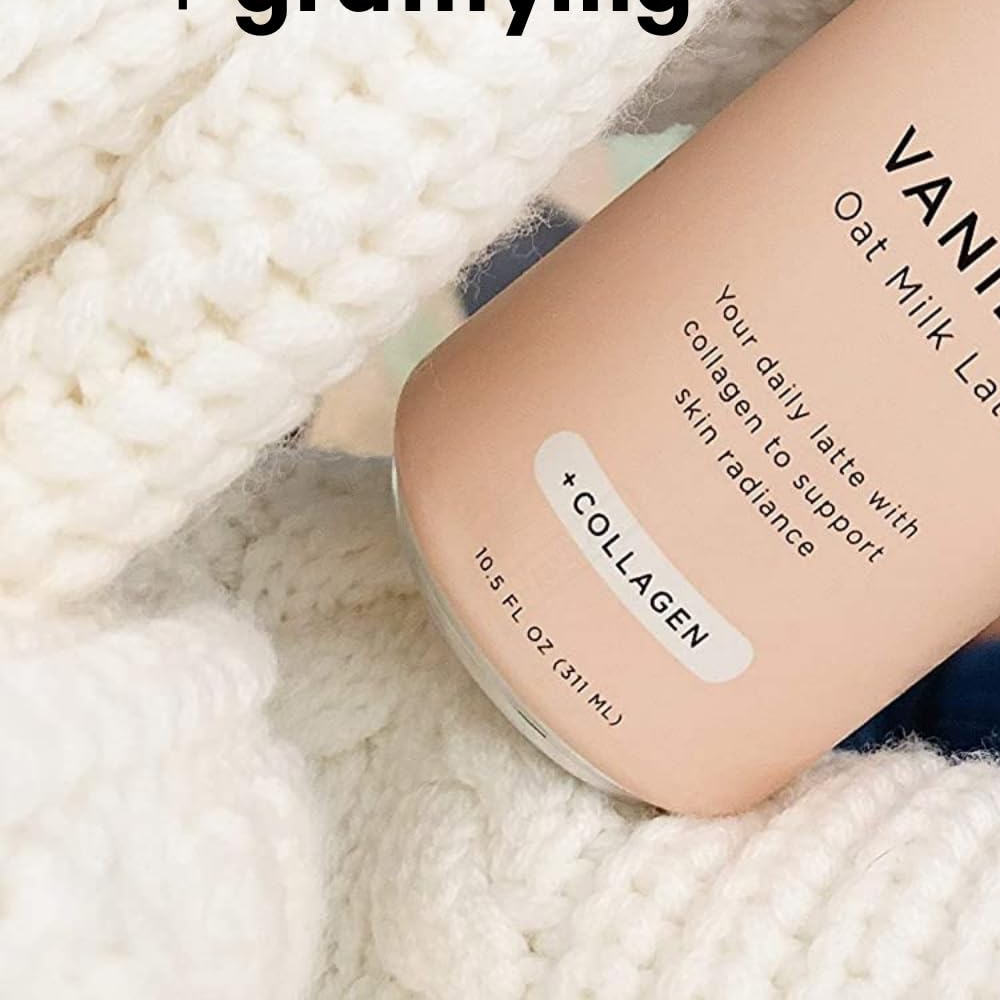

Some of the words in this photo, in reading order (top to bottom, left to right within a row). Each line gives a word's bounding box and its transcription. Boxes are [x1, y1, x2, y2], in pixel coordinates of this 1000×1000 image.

[834, 191, 888, 262] Oat
[885, 265, 954, 350] Milk
[674, 387, 718, 445] skin
[718, 447, 816, 559] radiance
[683, 319, 764, 434] collagen
[764, 435, 791, 469] to
[793, 472, 886, 564] support
[713, 284, 757, 348] Your
[756, 355, 810, 423] daily
[810, 423, 866, 490] latte
[869, 489, 920, 540] with
[474, 546, 504, 591] 10.5
[502, 593, 523, 623] FL
[527, 626, 554, 655] OZ
[553, 658, 589, 694] (311
[588, 693, 623, 726] ML)
[562, 471, 710, 649] +COLLAGEN
